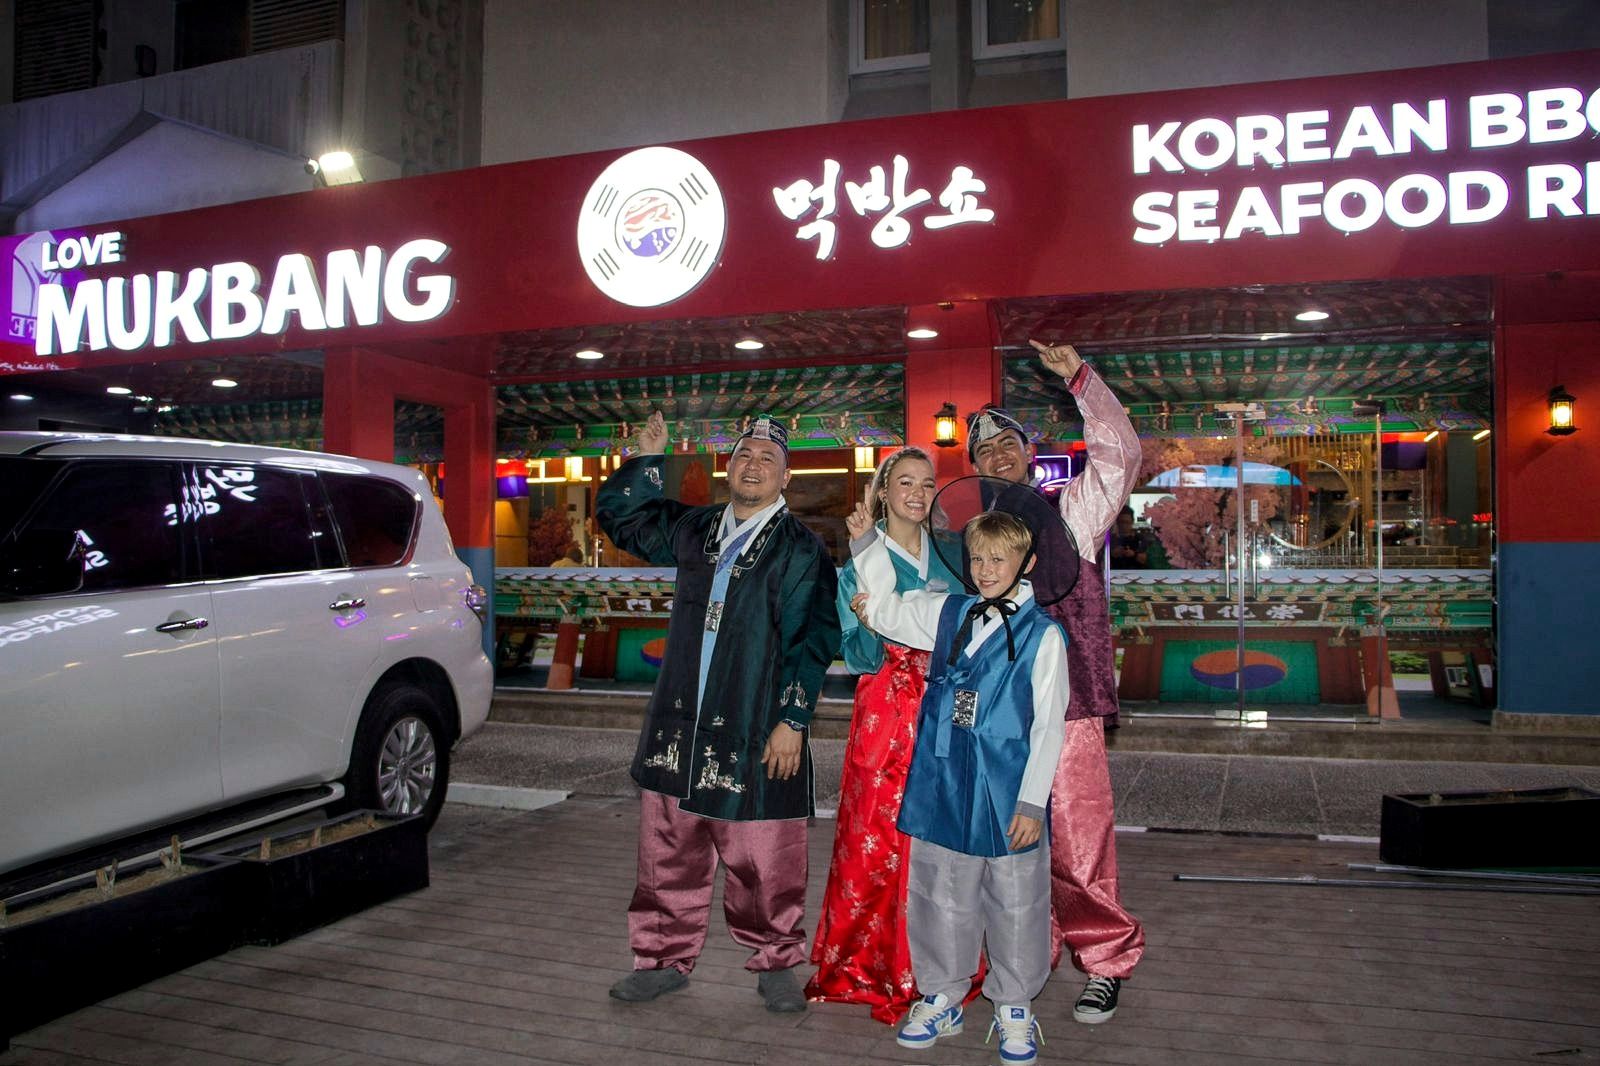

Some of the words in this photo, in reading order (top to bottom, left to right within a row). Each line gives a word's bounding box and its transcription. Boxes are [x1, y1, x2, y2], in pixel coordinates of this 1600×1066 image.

[1132, 99, 1448, 174] KOREAN
[1469, 87, 1600, 148] BB
[772, 155, 995, 260] 먹방쇼
[1132, 170, 1509, 244] SEAFOOD
[41, 231, 121, 272] LOVE
[35, 239, 452, 356] MUKBANG
